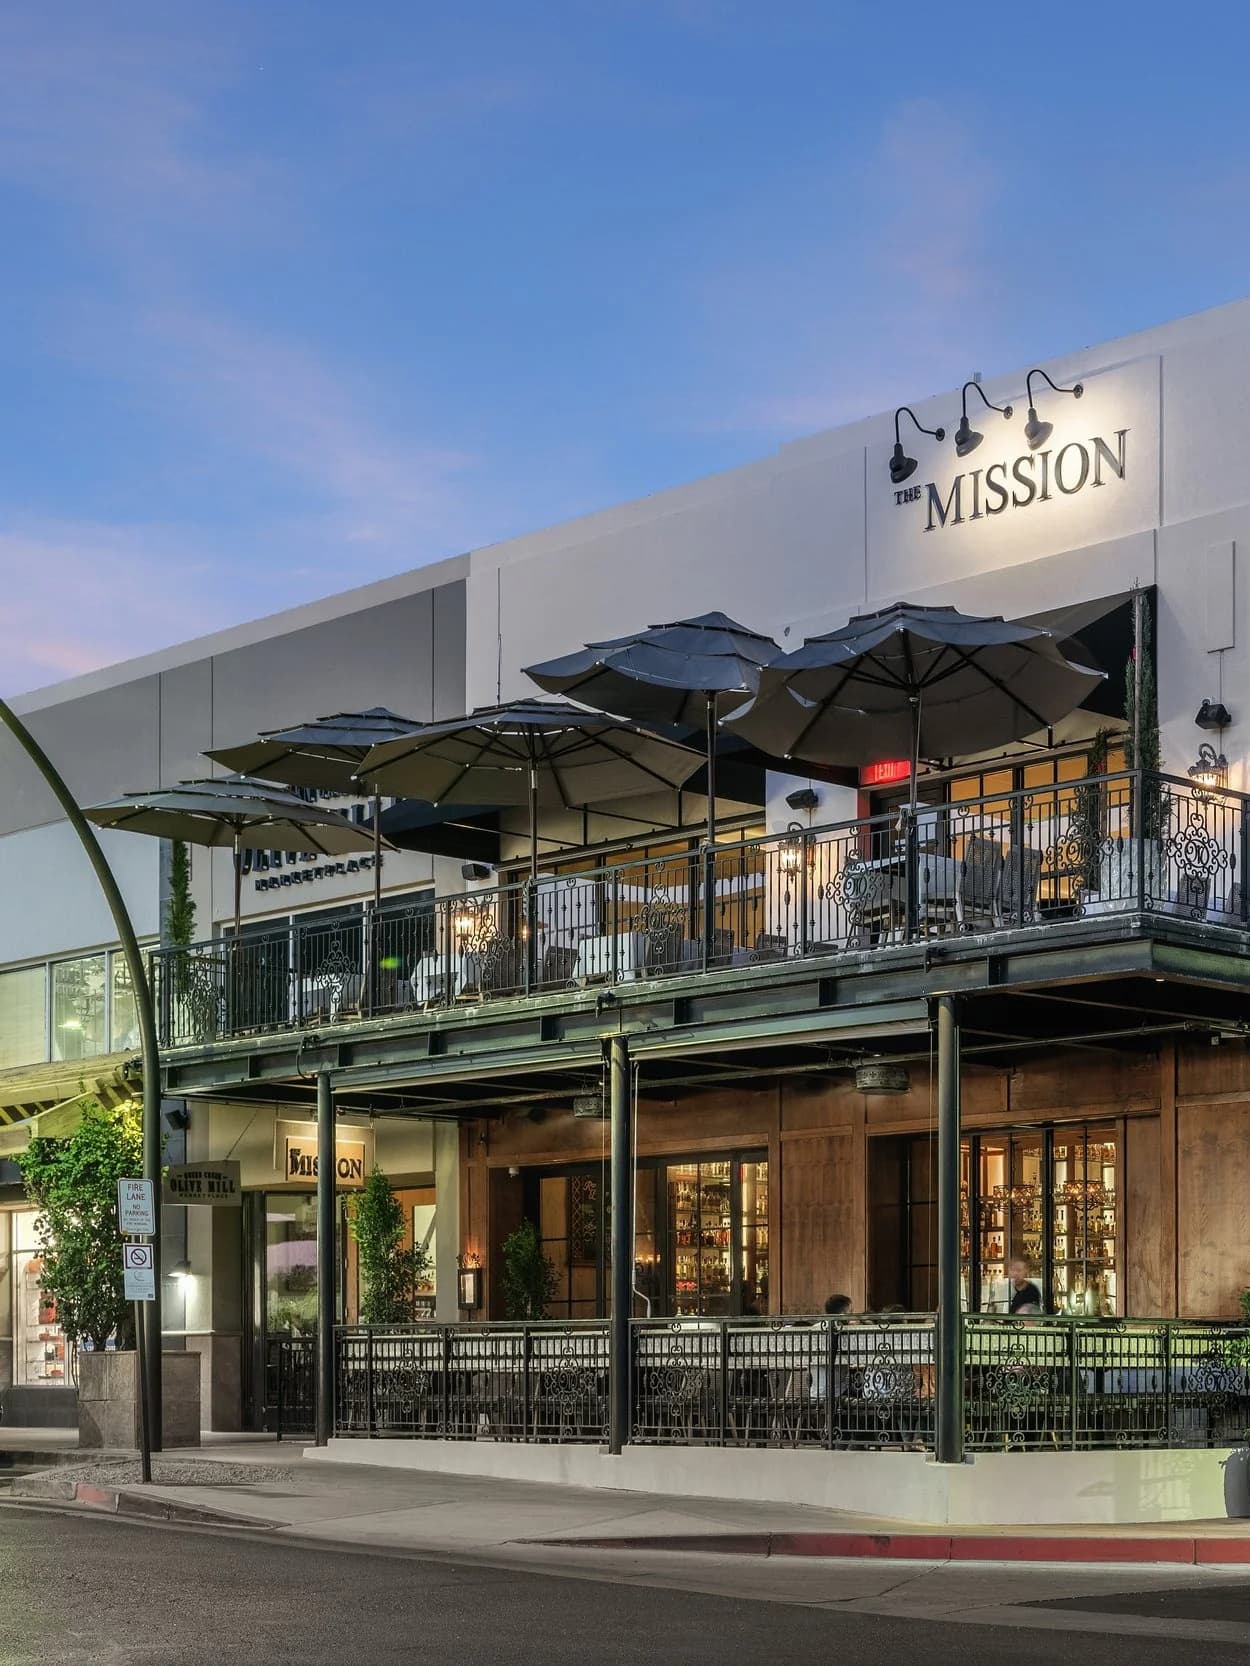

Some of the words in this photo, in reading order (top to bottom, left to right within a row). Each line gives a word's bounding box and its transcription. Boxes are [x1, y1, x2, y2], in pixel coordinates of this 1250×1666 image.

[894, 485, 922, 506] THE
[922, 428, 1131, 533] MISSION
[289, 1155, 362, 1179] MISON
[127, 1183, 144, 1191] FIRE
[170, 1179, 202, 1193] OLIVE
[208, 1180, 236, 1193] MILL
[126, 1193, 145, 1201] LANE
